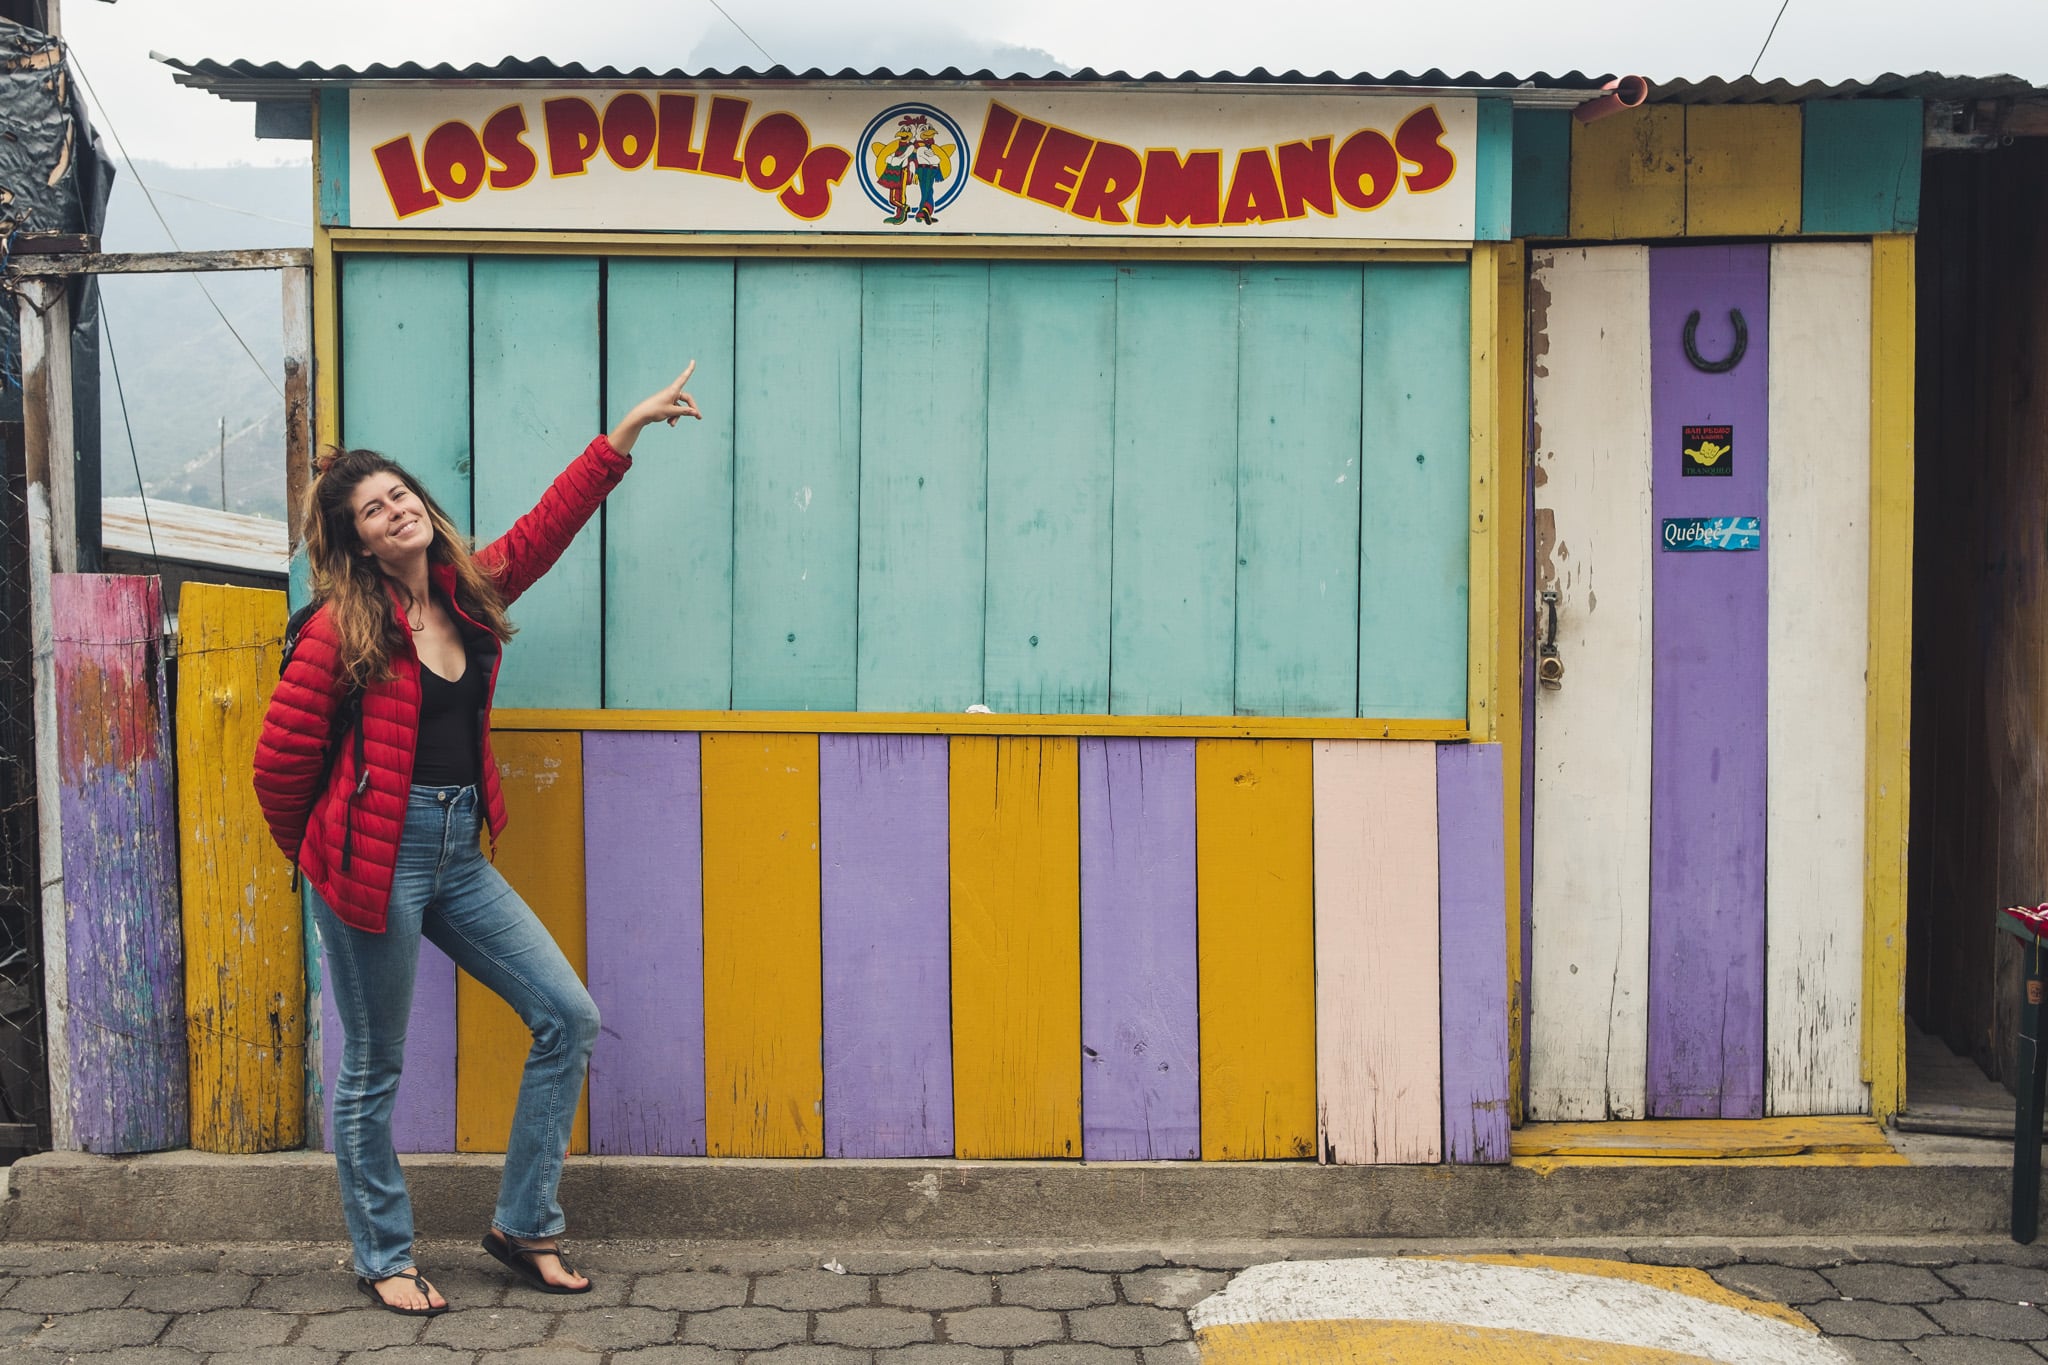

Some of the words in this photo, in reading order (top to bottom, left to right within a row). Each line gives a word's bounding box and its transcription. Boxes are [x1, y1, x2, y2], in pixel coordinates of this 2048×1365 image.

[371, 102, 539, 221] LOS
[542, 91, 852, 221] POLLOS
[971, 98, 1458, 229] HERMANOS
[1665, 522, 1721, 546] Québec
